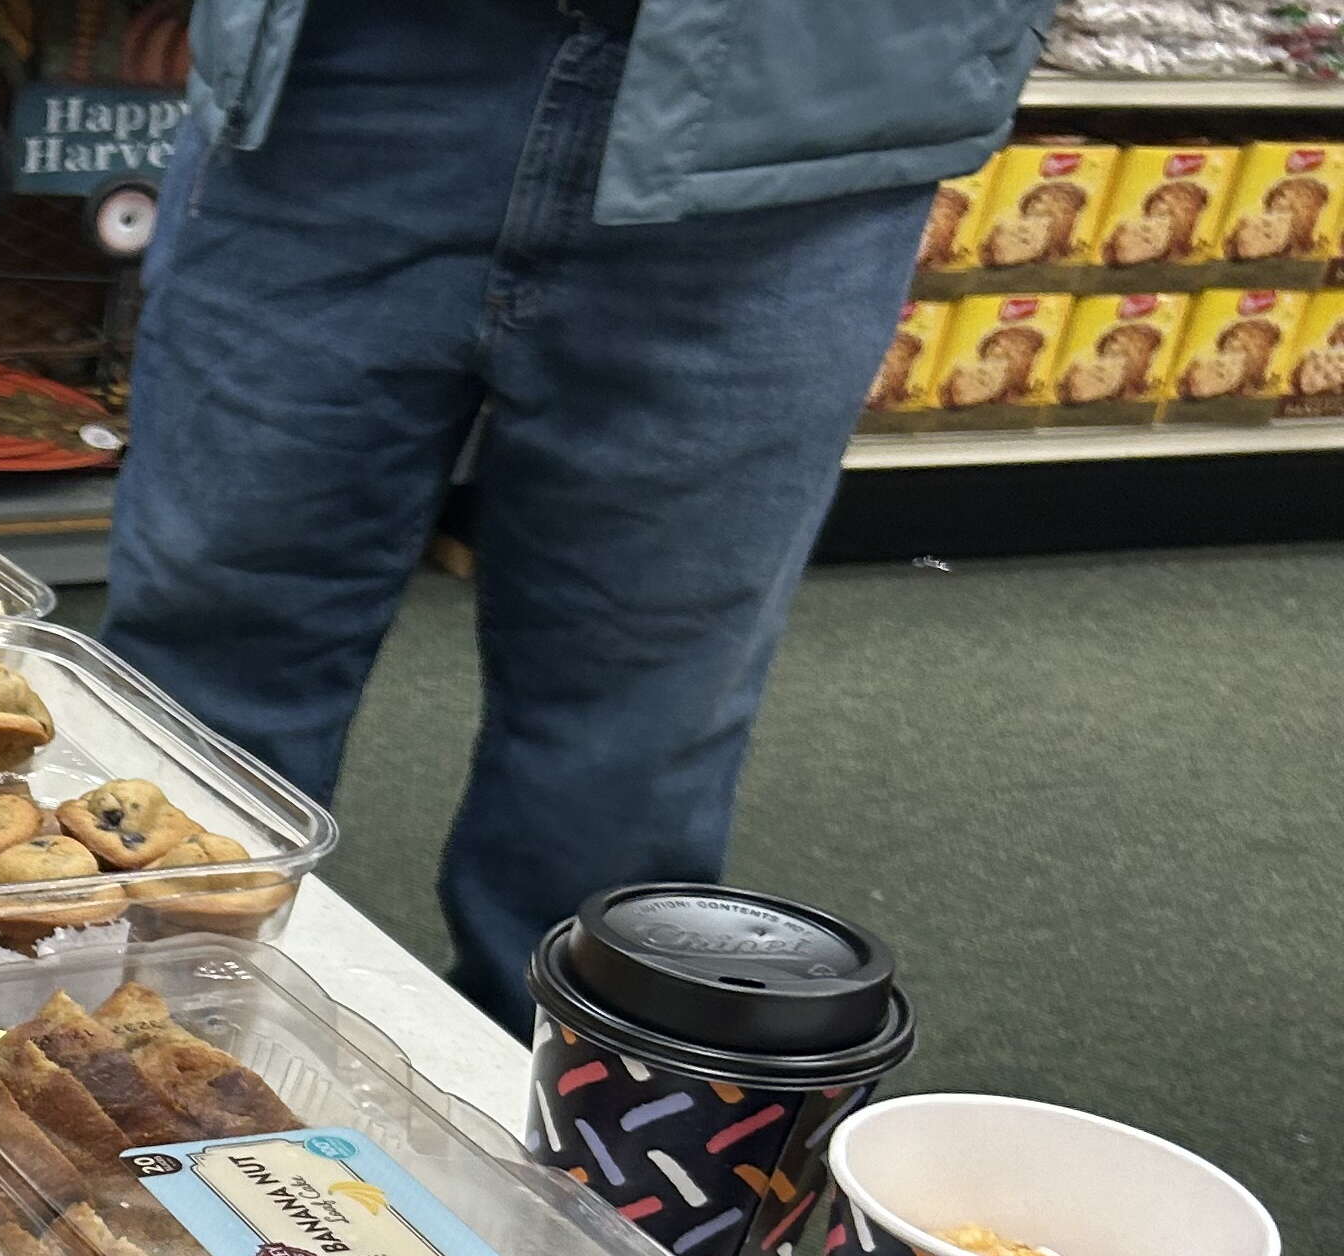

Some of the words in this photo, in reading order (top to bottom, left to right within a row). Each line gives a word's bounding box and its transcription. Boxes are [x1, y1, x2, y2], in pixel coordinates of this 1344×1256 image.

[21, 136, 176, 173] Harve
[696, 900, 780, 922] CONTENTS
[133, 1156, 166, 1174] 20
[228, 1156, 280, 1185] NUT
[266, 1186, 350, 1253] BANANA
